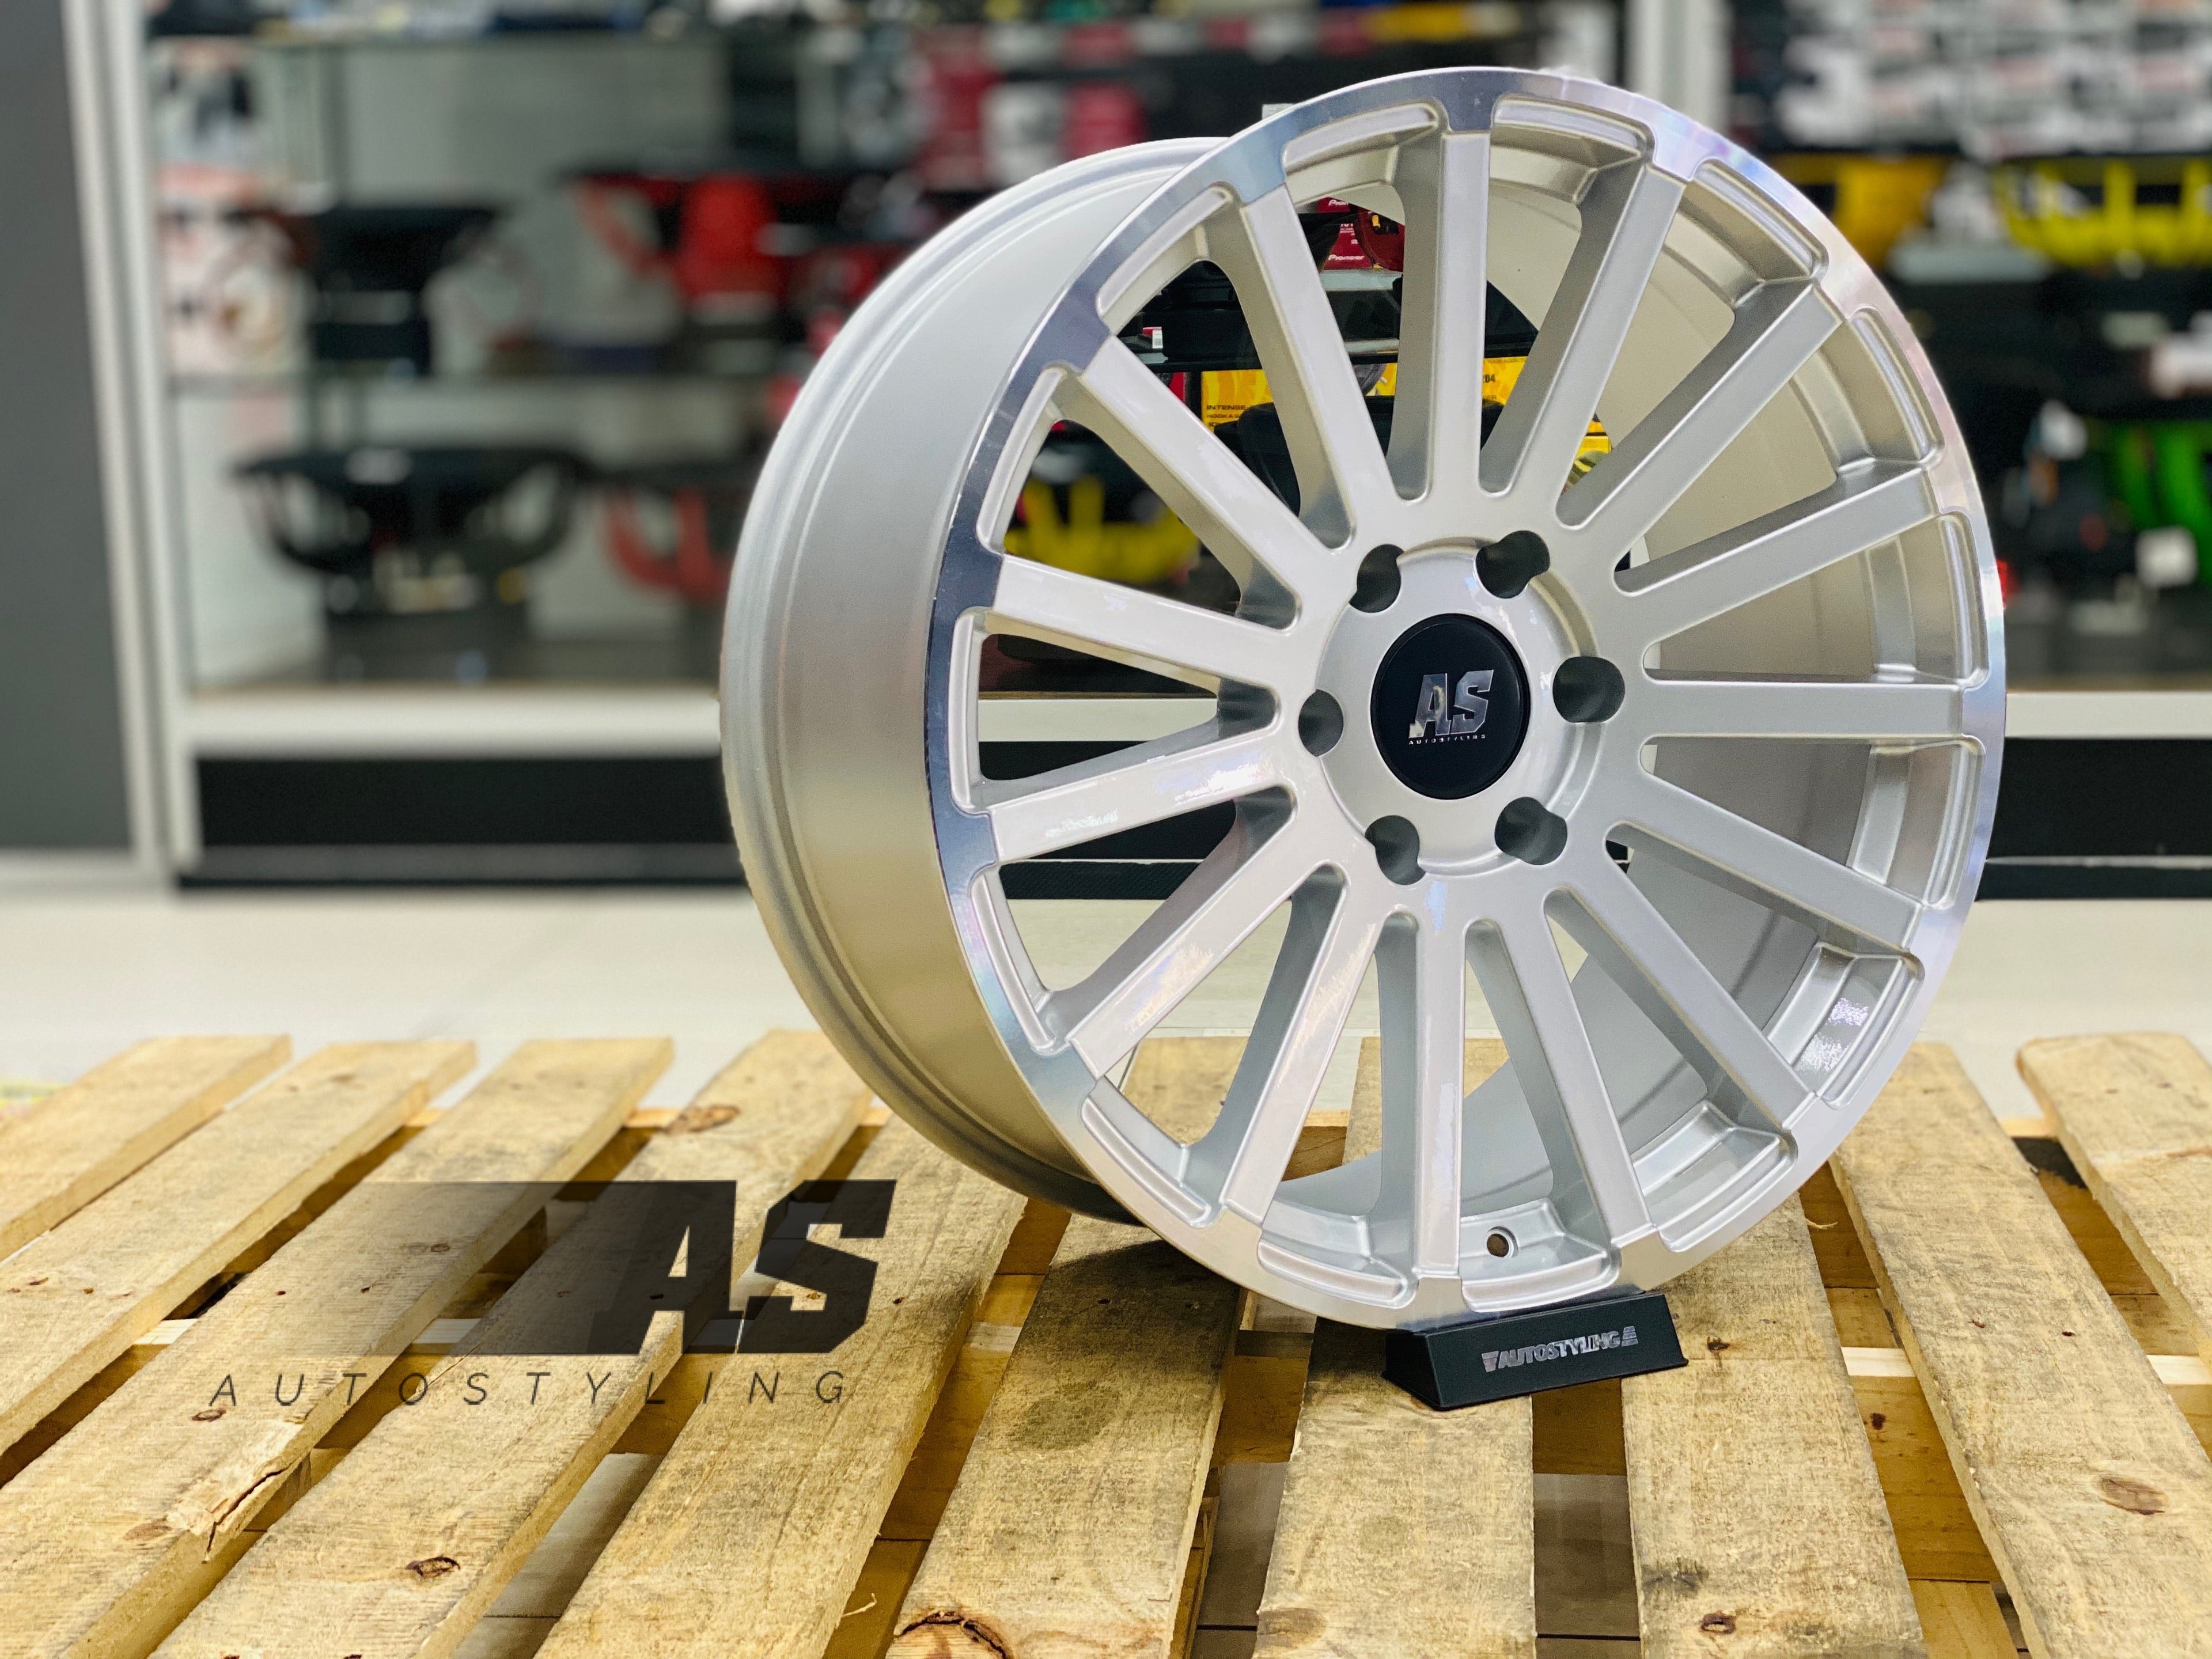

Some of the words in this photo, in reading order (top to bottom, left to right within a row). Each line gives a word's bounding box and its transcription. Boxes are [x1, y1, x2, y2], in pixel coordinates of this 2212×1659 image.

[1408, 669, 1494, 738] AS
[1408, 734, 1486, 745] AUTOSTYLING
[1498, 1331, 1620, 1369] AUTOSTYLING
